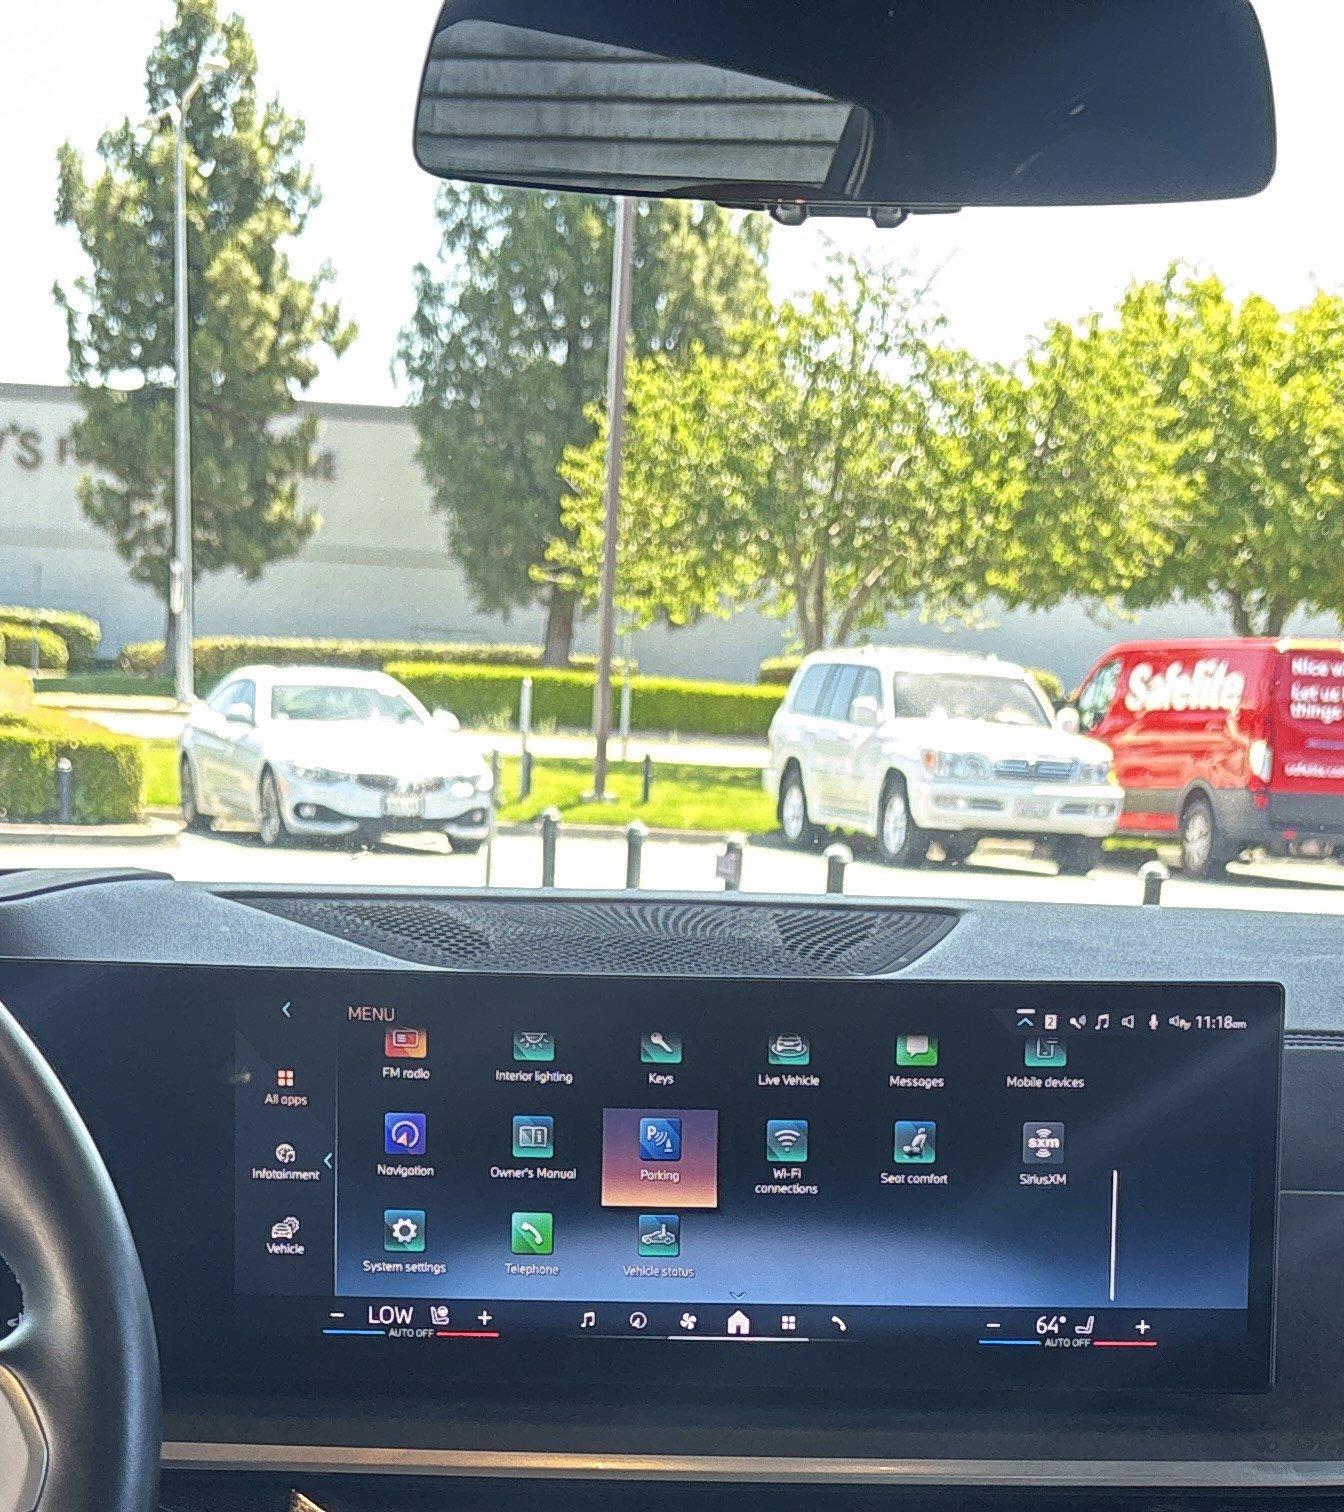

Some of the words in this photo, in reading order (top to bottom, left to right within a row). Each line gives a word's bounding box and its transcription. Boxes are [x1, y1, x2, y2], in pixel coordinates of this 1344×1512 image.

[1125, 656, 1248, 713] Safelite
[348, 1006, 395, 1022] MENU
[382, 1067, 400, 1080] FM
[401, 1067, 430, 1080] radio
[495, 1070, 533, 1083] Interior
[535, 1070, 573, 1085] lighting
[648, 1073, 674, 1086] Keys
[758, 1074, 780, 1086] Live
[782, 1074, 820, 1087] Vehicle
[889, 1075, 945, 1090] Messages
[1006, 1076, 1043, 1089] Mobile
[1044, 1077, 1085, 1089] devices
[264, 1094, 280, 1106] All
[280, 1095, 308, 1108] apps
[252, 1168, 320, 1182] Infotainment
[377, 1164, 434, 1178] Navigation
[490, 1166, 534, 1180] Owner's
[536, 1167, 577, 1180] Manual
[640, 1169, 680, 1183] Parking
[773, 1168, 801, 1180] Wi-Fi
[880, 1173, 906, 1185] Seat
[906, 1173, 949, 1186] comfort
[1019, 1173, 1067, 1186] SiriusXM
[755, 1183, 818, 1195] connections
[266, 1243, 305, 1255] Vehicle
[363, 1261, 404, 1275] System
[405, 1261, 447, 1275] settings
[505, 1264, 559, 1278] Telephone
[623, 1265, 660, 1278] Vehicle
[661, 1266, 695, 1278] status
[368, 1306, 413, 1325] LOW
[388, 1328, 413, 1339] AUTO
[415, 1328, 435, 1339] OFF
[1044, 1338, 1070, 1348] AUTO
[1072, 1338, 1091, 1348] OFF
